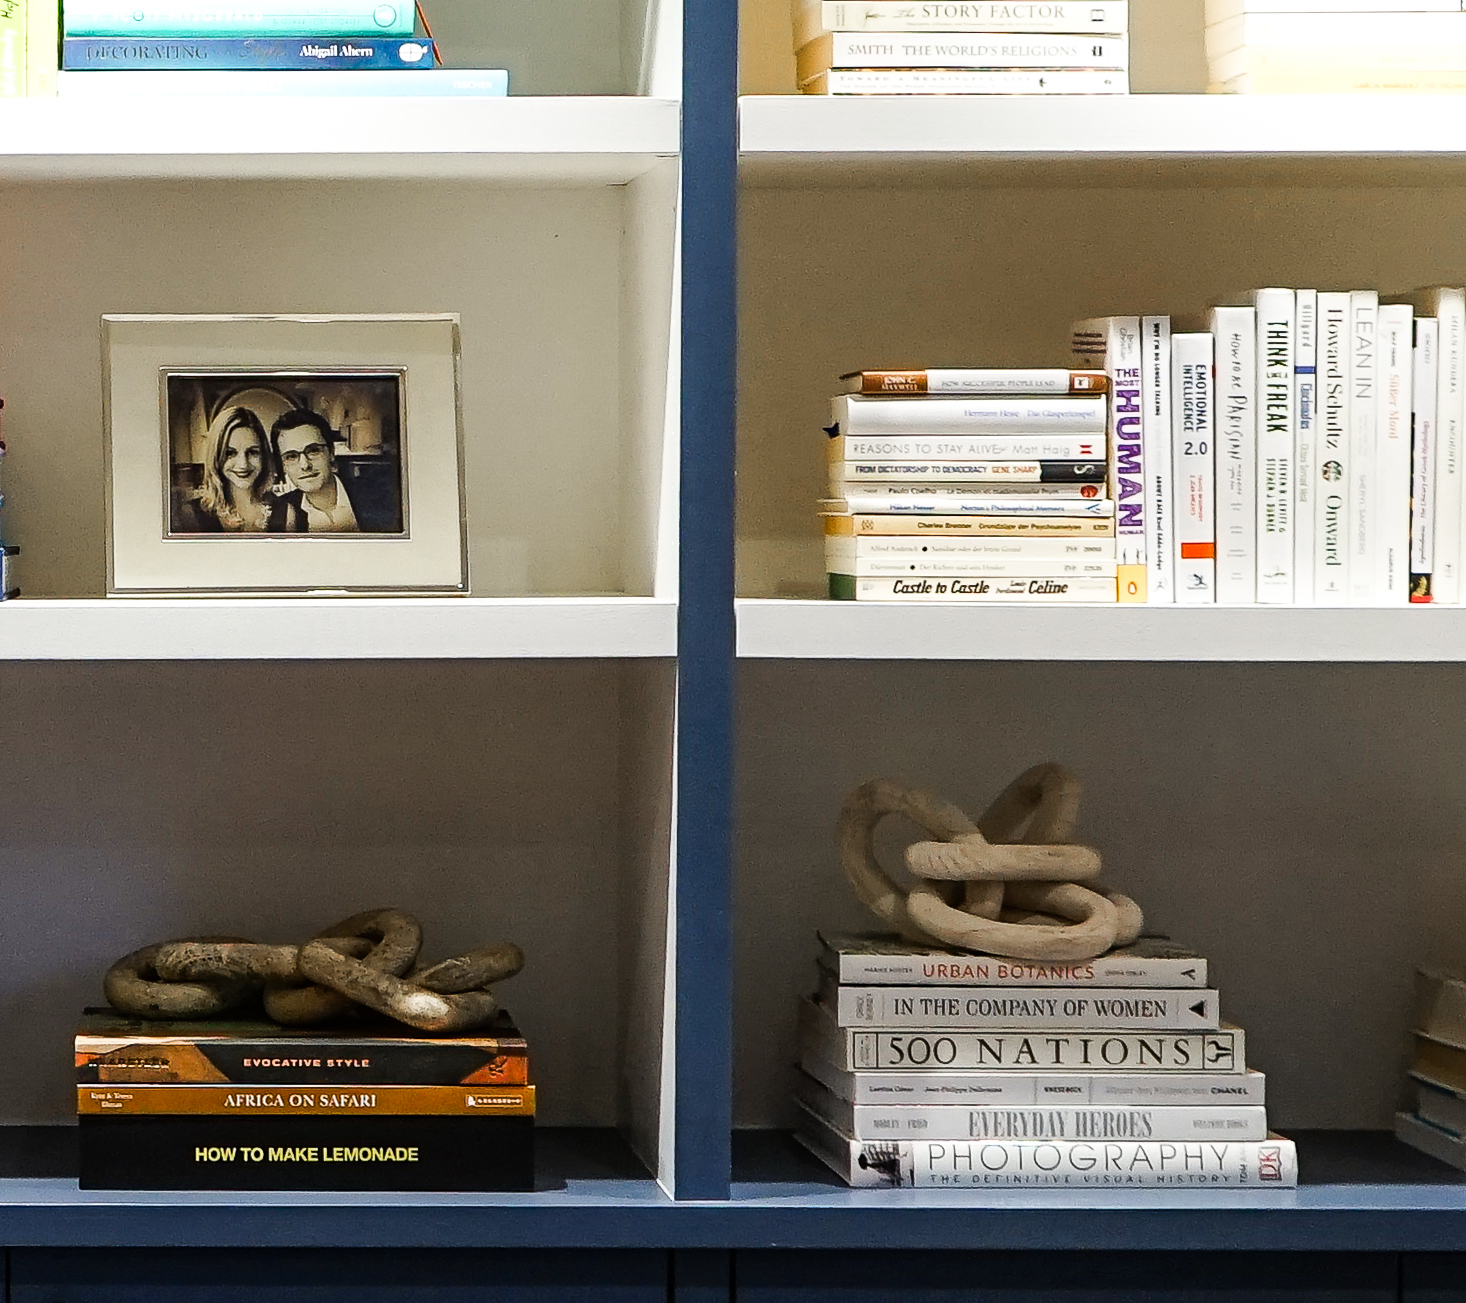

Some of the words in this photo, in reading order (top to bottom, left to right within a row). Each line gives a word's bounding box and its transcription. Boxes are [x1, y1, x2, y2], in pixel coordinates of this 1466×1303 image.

[299, 44, 338, 58] Abigail
[341, 46, 373, 57] Ahern
[1267, 321, 1288, 367] THINK
[1326, 308, 1343, 379] Howard
[1183, 365, 1193, 432] INTELLIGENCE
[1195, 365, 1206, 432] EMOTIONAL
[1267, 384, 1287, 433] FREAK
[1326, 383, 1343, 449] Schultz
[1116, 389, 1143, 527] HUMAN
[1184, 442, 1208, 455] 2.0
[893, 580, 932, 594] Castle
[936, 581, 947, 594] to
[951, 581, 989, 594] Castle
[922, 964, 988, 980] URBAN
[998, 964, 1094, 980] BOTANICS
[894, 1000, 914, 1015] IN
[921, 999, 959, 1015] THE
[966, 999, 1057, 1017] COMPANY
[1063, 999, 1088, 1017] OF
[1094, 999, 1167, 1018] WOMEN
[243, 1059, 321, 1068] EVOCATIVE
[327, 1059, 370, 1068] STYLE
[889, 1037, 957, 1065] 500
[977, 1038, 1190, 1065] NATIONS
[224, 1095, 284, 1108] AFRICA
[290, 1095, 313, 1107] ON
[319, 1094, 377, 1107] SAFARI
[969, 1112, 1069, 1137] EVERYDAY
[1075, 1112, 1152, 1137] HEROES
[195, 1148, 236, 1162] HOW
[240, 1147, 264, 1162] TO
[269, 1147, 318, 1162] MAKE
[323, 1147, 418, 1162] LEMONADE
[928, 1144, 1229, 1171] PHOTOGRAPHY
